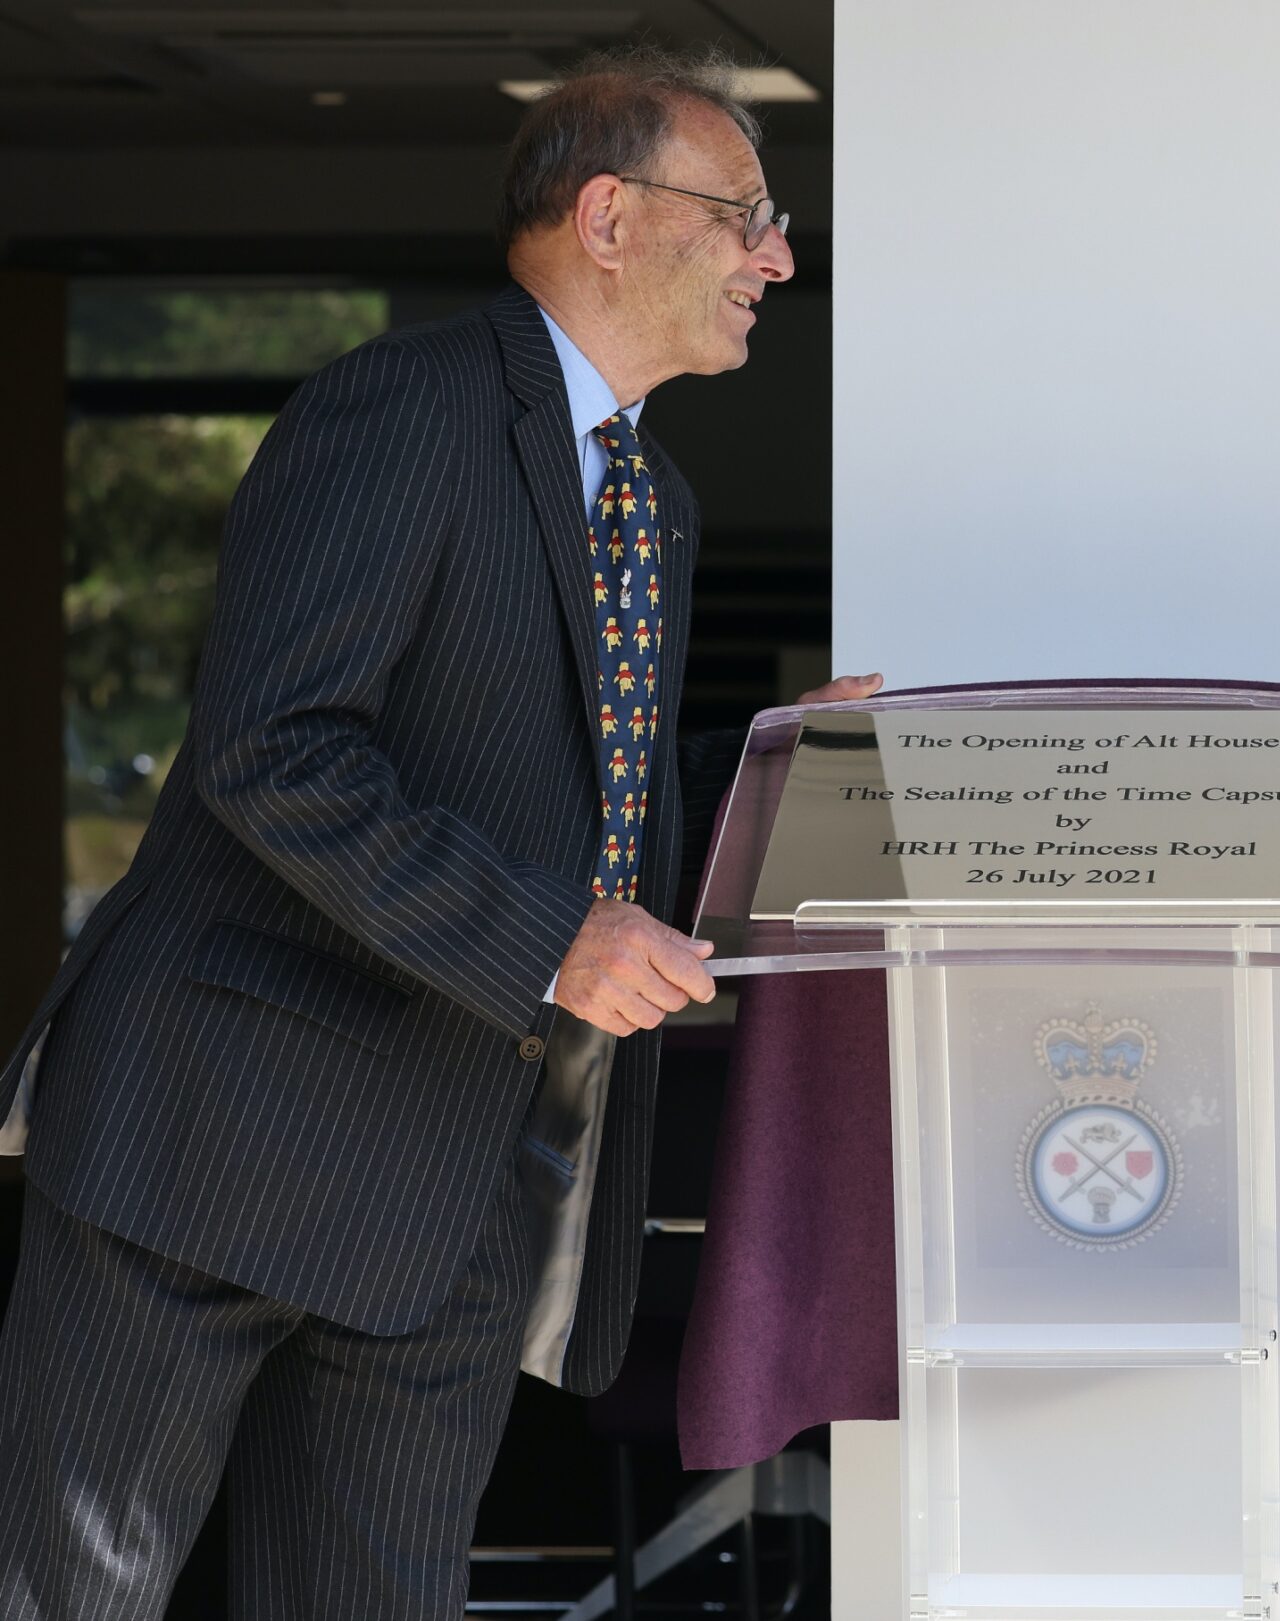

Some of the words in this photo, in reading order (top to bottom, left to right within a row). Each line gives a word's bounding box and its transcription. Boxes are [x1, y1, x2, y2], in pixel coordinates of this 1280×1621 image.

[897, 734, 953, 748] The
[961, 734, 1086, 751] Opening
[1094, 734, 1130, 748] of
[1133, 734, 1179, 748] Alt
[1187, 734, 1280, 748] House
[1056, 760, 1109, 775] and
[839, 786, 895, 801] The
[904, 786, 1015, 804] Sealing
[1022, 786, 1059, 801] of
[1063, 786, 1108, 801] the
[1116, 786, 1192, 801] Time
[1055, 813, 1093, 832] by
[881, 840, 961, 856] HRH
[967, 840, 1026, 856] The
[1033, 840, 1159, 856] Princess
[1167, 841, 1257, 860] Royal
[965, 869, 1005, 884] 26
[1011, 868, 1077, 888] July
[1084, 869, 1156, 884] 2021
